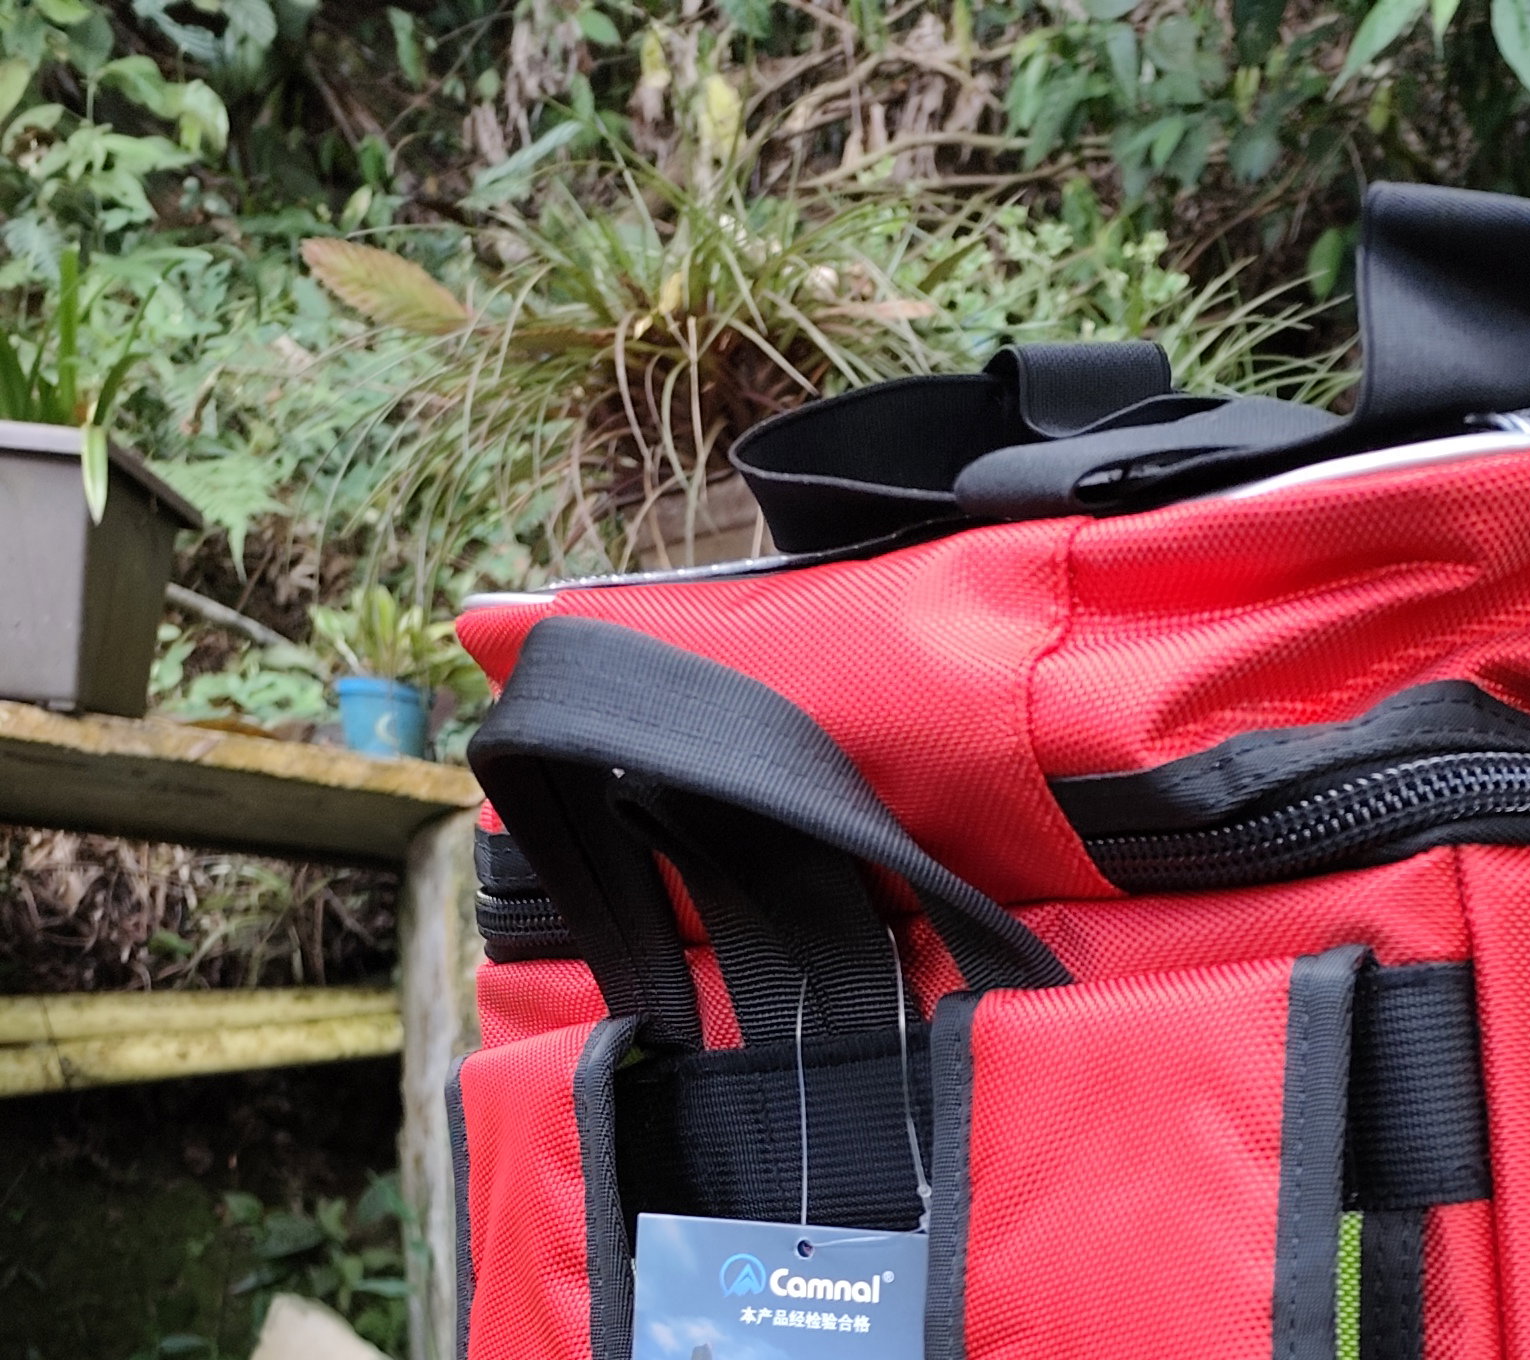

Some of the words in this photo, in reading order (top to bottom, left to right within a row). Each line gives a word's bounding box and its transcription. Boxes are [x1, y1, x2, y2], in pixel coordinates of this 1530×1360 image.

[739, 1305, 871, 1333] 本产品经检验合格
